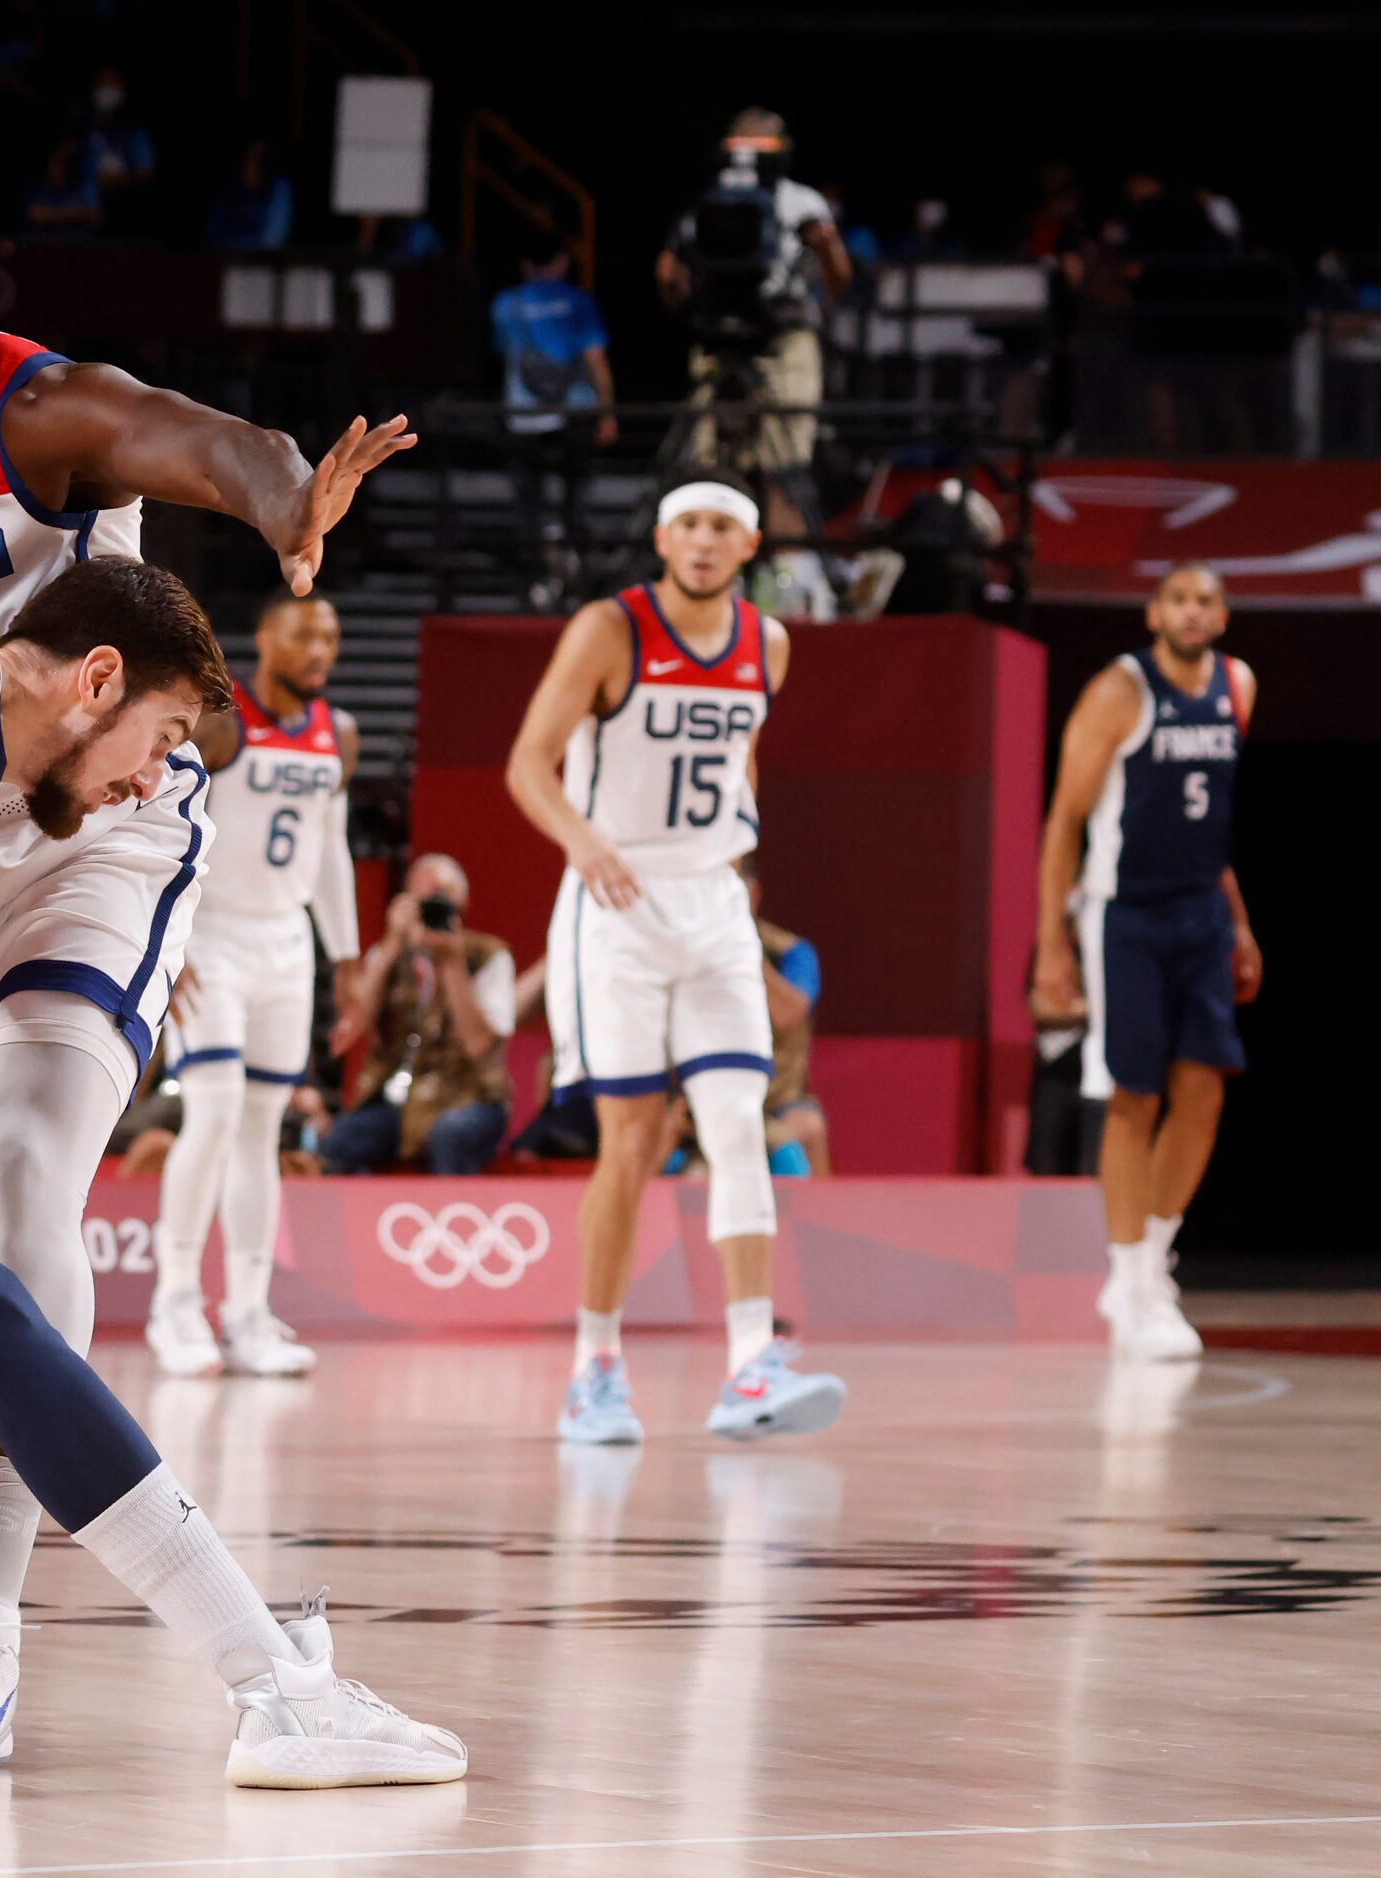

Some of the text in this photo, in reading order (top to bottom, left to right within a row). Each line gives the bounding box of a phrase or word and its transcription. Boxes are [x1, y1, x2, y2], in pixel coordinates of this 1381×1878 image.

[645, 700, 754, 742] USA
[667, 756, 727, 828] 15
[1183, 772, 1210, 821] 5
[266, 808, 302, 867] 6
[81, 1217, 160, 1273] 02
